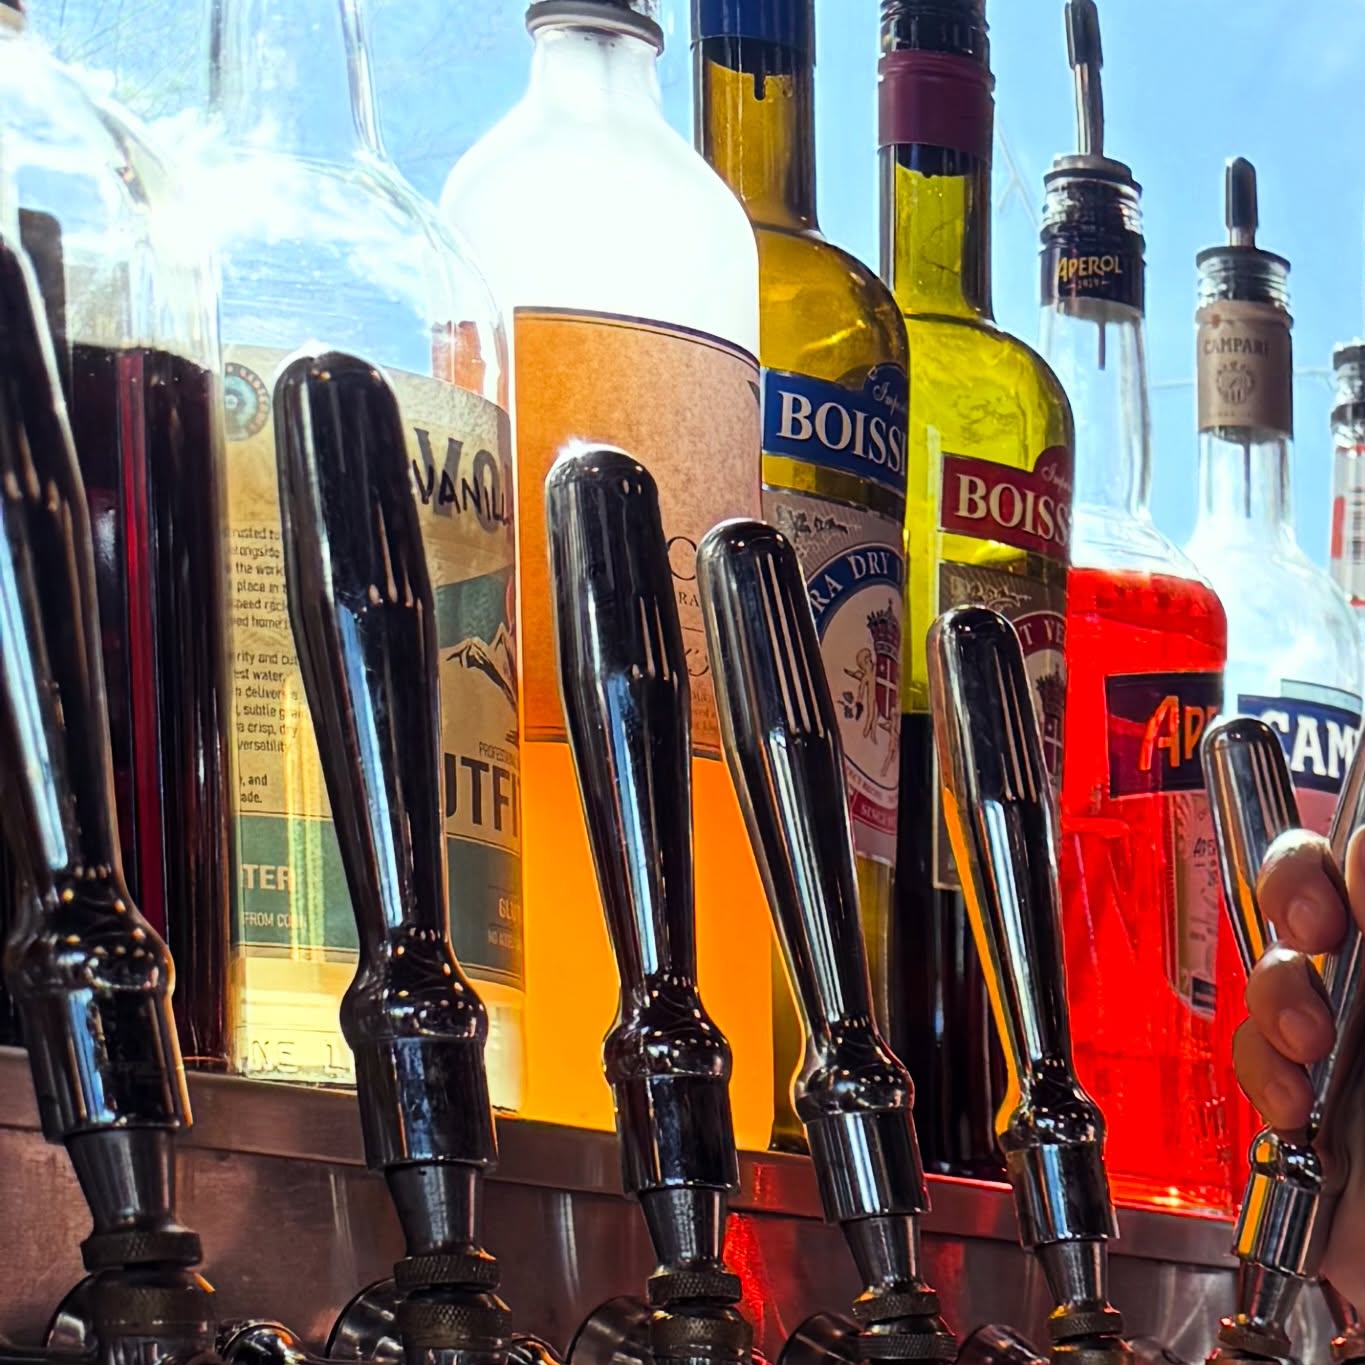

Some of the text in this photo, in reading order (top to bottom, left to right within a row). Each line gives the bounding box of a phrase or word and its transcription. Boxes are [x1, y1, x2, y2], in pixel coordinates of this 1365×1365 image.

[1058, 255, 1122, 282] APEROL
[1203, 337, 1270, 356] CAMPARI
[846, 551, 891, 580] DRY
